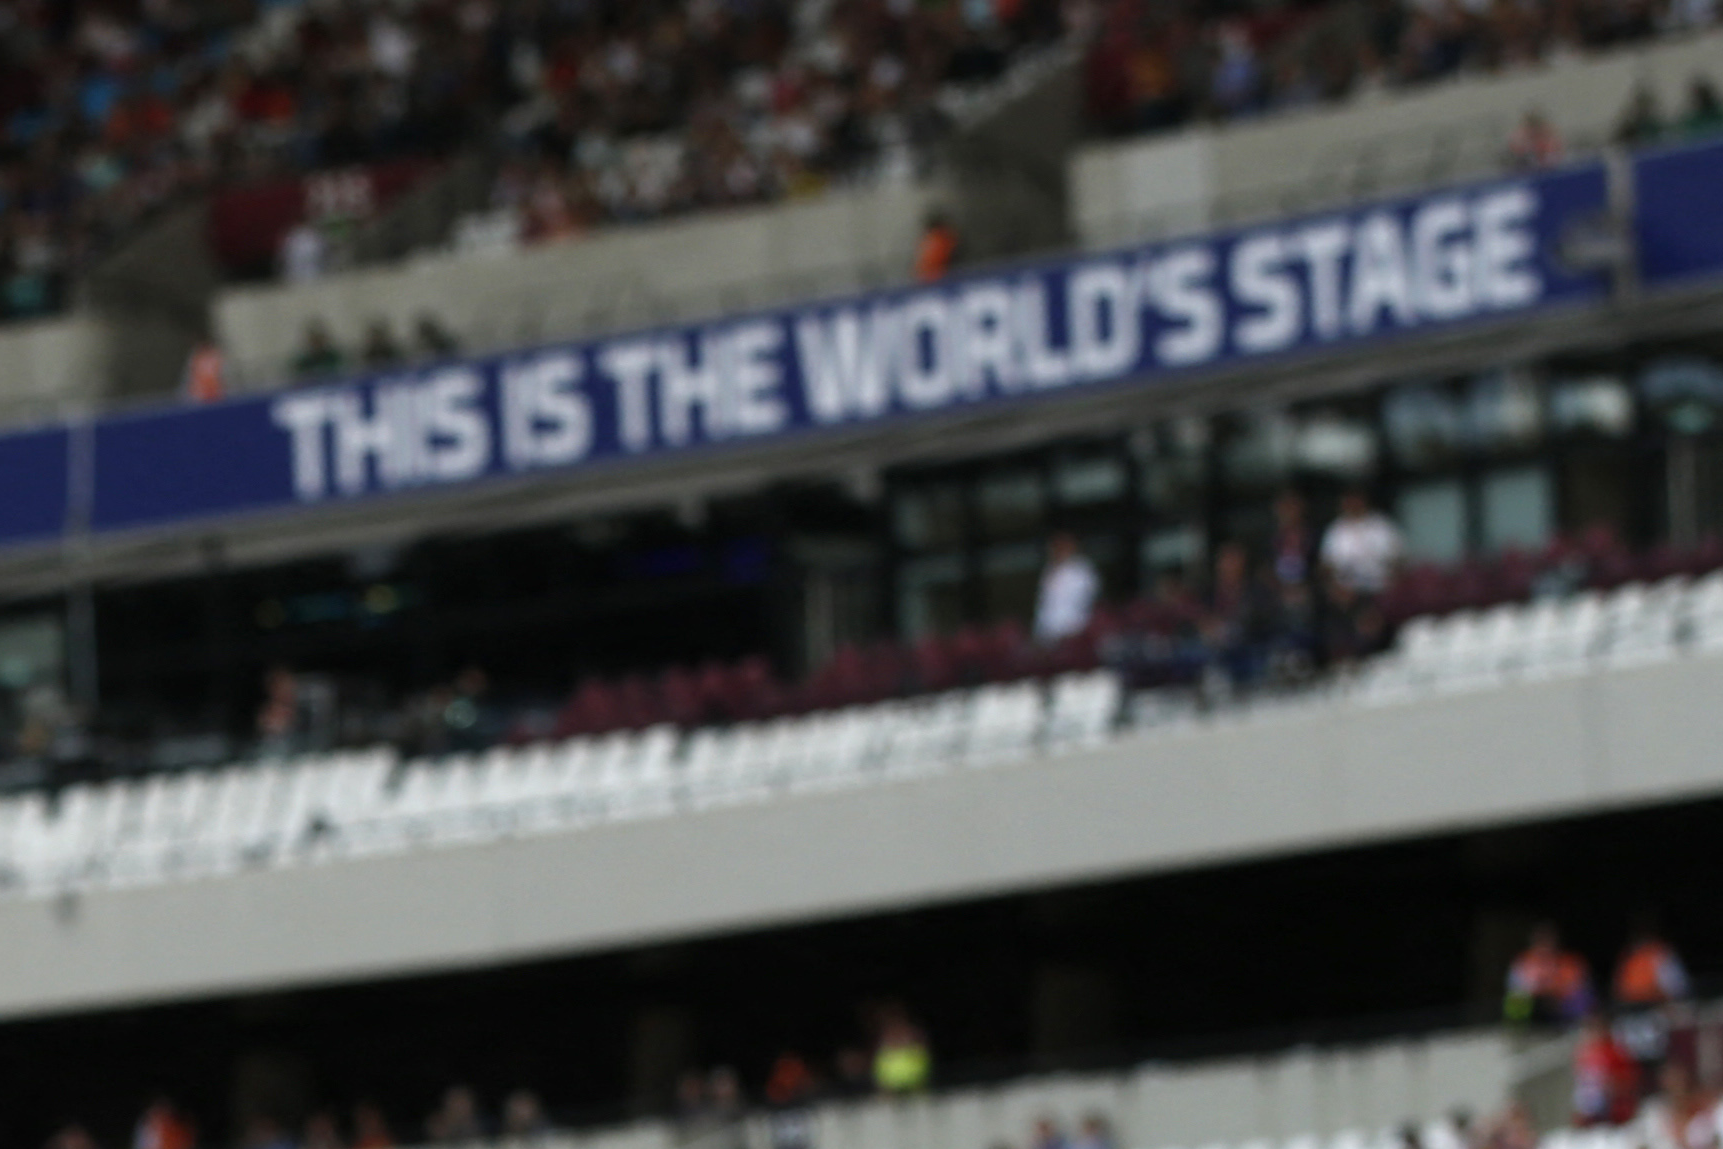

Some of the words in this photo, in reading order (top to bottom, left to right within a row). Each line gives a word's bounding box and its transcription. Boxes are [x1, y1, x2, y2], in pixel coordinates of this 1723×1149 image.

[275, 366, 485, 497] THIS
[498, 350, 591, 467] IS
[598, 320, 785, 450] THE
[793, 247, 1222, 423] WORLD'S
[1230, 187, 1541, 353] STAGE
